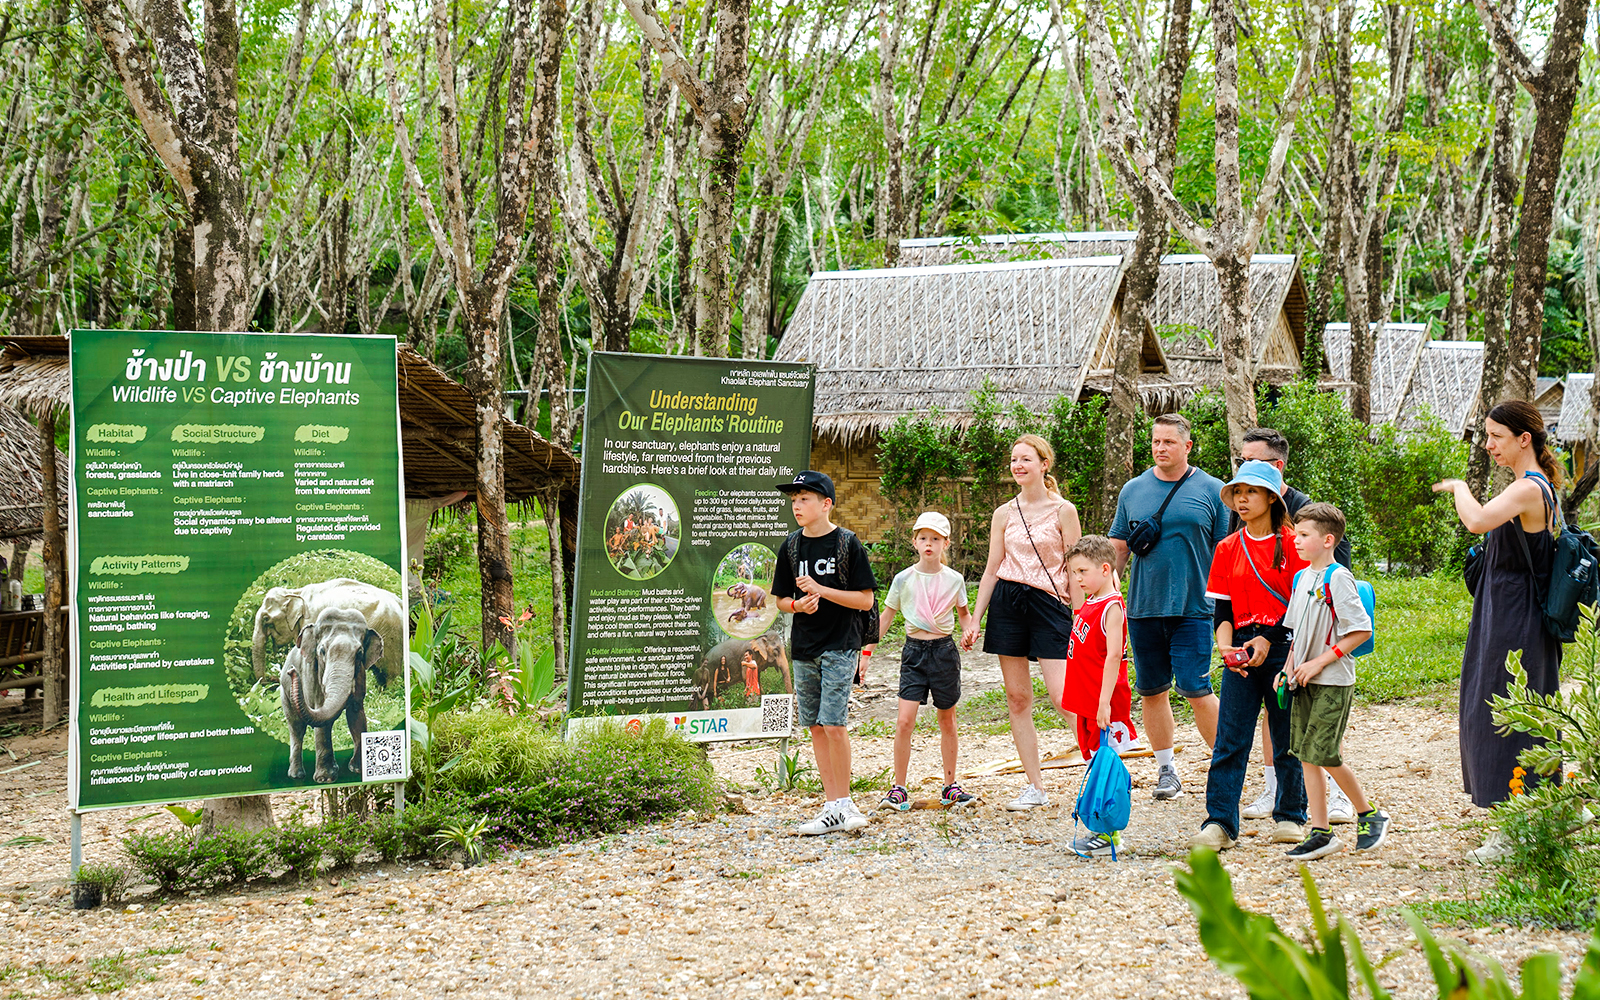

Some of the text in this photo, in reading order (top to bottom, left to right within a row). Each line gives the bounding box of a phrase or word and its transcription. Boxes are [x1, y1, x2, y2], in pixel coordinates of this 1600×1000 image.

[125, 349, 352, 384] ช้างป่า VS ช้างบ้าน
[721, 376, 809, 389] Khaolak Elephant Sanctuary
[113, 385, 359, 409] Wildlife VS Captive Elephants
[650, 391, 757, 414] Understanding
[619, 411, 648, 430] Our
[99, 428, 133, 438] Habitat
[183, 428, 256, 438] Social Structure
[312, 428, 329, 438] Diet
[605, 437, 780, 453] In our sanctuary, elephants enjoy a natural
[86, 448, 117, 456] Wildlife
[172, 448, 202, 456] Wildlife
[604, 450, 771, 466] lifestyle, far removed from their previous
[86, 470, 161, 480] forests, grasslands
[173, 470, 189, 478] Live
[191, 470, 197, 478] in
[199, 470, 238, 478] close-knit
[238, 470, 261, 480] family
[603, 462, 793, 477] hardships. Here's a brief look at their daily life:
[173, 479, 189, 487] with
[198, 479, 233, 487] matriarch
[87, 487, 160, 497] Captive Elephants
[695, 489, 718, 498] Feeding:
[730, 489, 756, 498] elephants
[174, 495, 242, 506] Captive Elephants
[296, 502, 361, 512] Captive Elephants
[88, 509, 133, 517] sanctuaries
[174, 517, 197, 525] Social
[199, 516, 236, 527] dynamics
[237, 518, 253, 526] may
[255, 516, 265, 524] be
[266, 515, 291, 524] altered
[174, 526, 232, 536] due to captivity
[296, 522, 380, 534] Regulated diet provided
[297, 532, 345, 543] by caretakers
[102, 558, 181, 572] Activity Patterns
[89, 580, 120, 589] Wildlife
[618, 589, 640, 598] Bathing:
[607, 597, 619, 606] play
[631, 597, 642, 606] part
[589, 606, 616, 614] activities,
[628, 605, 668, 614] performances.
[670, 605, 684, 613] They
[89, 610, 210, 622] Natural behaviors like foraging,
[640, 613, 652, 622] they
[653, 613, 673, 622] please,
[90, 621, 156, 633] roaming, bathing
[90, 637, 161, 650] Captive Elephants
[90, 656, 214, 671] Activities planned by caretakers
[104, 686, 198, 701] Health and Lifespan
[90, 713, 122, 722] Wildlife
[690, 718, 728, 734] STAR
[90, 725, 255, 747] Generally longer lifespan and better health
[91, 749, 163, 764] Captive Elephants
[91, 774, 133, 785] Influenced
[135, 773, 145, 784] by
[147, 771, 160, 780] the
[160, 769, 188, 781] quality
[189, 768, 197, 777] of
[218, 764, 251, 777] provided
